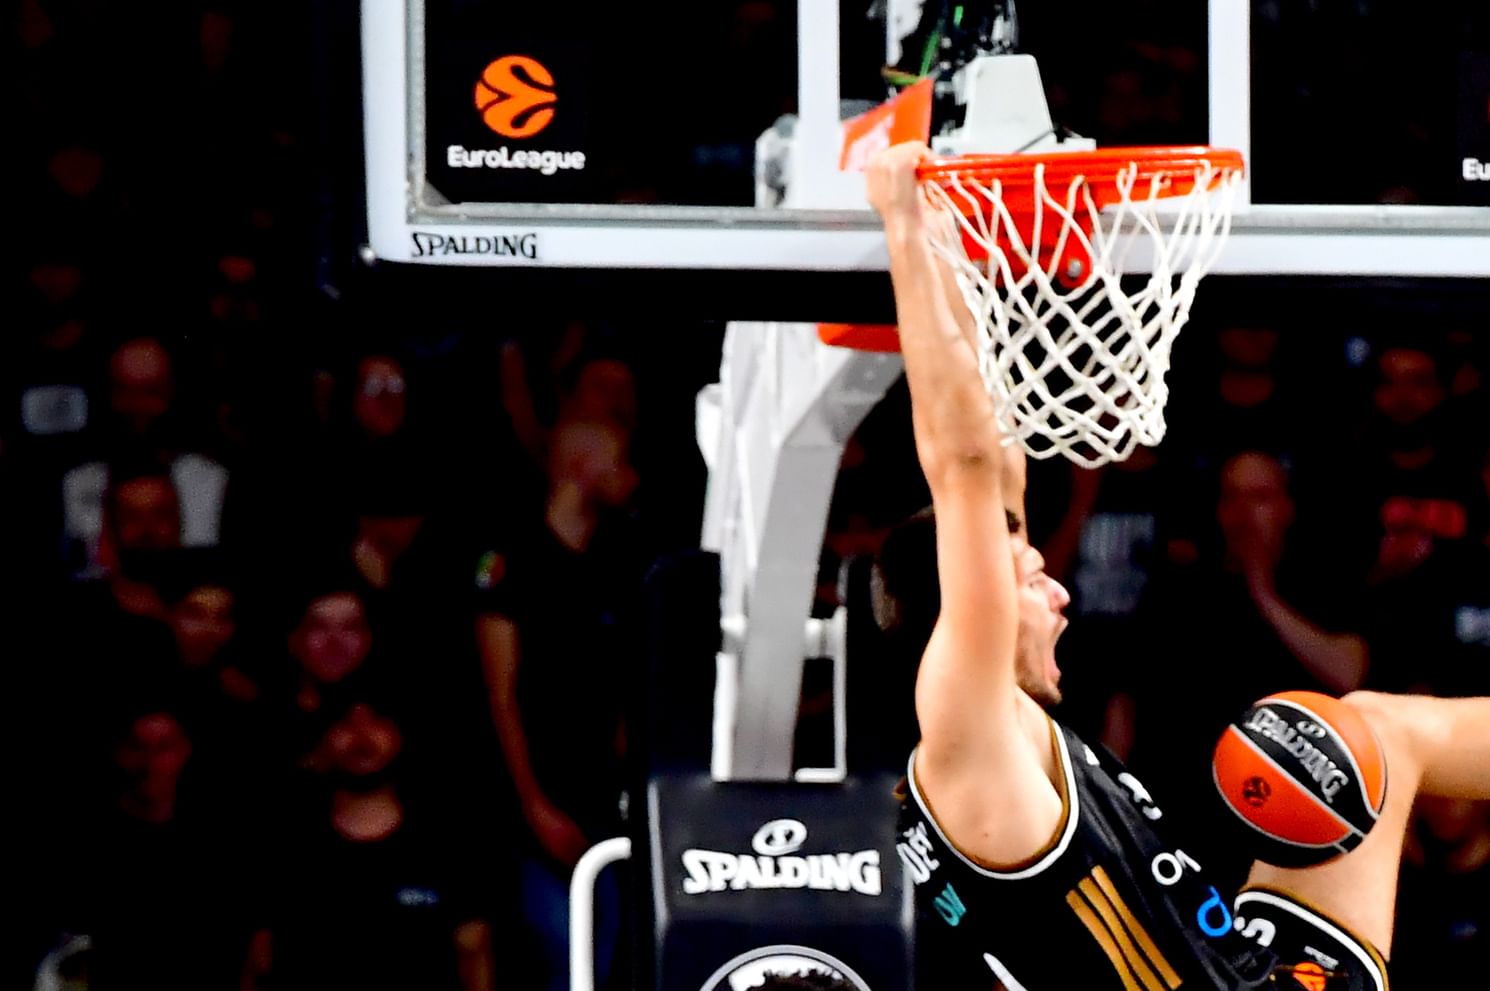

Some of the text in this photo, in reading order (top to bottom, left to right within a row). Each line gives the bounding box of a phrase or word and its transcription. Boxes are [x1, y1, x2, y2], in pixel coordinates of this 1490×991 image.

[447, 145, 586, 175] EuroLeague
[411, 231, 538, 259] SPALDING
[682, 849, 882, 895] SPALDING
